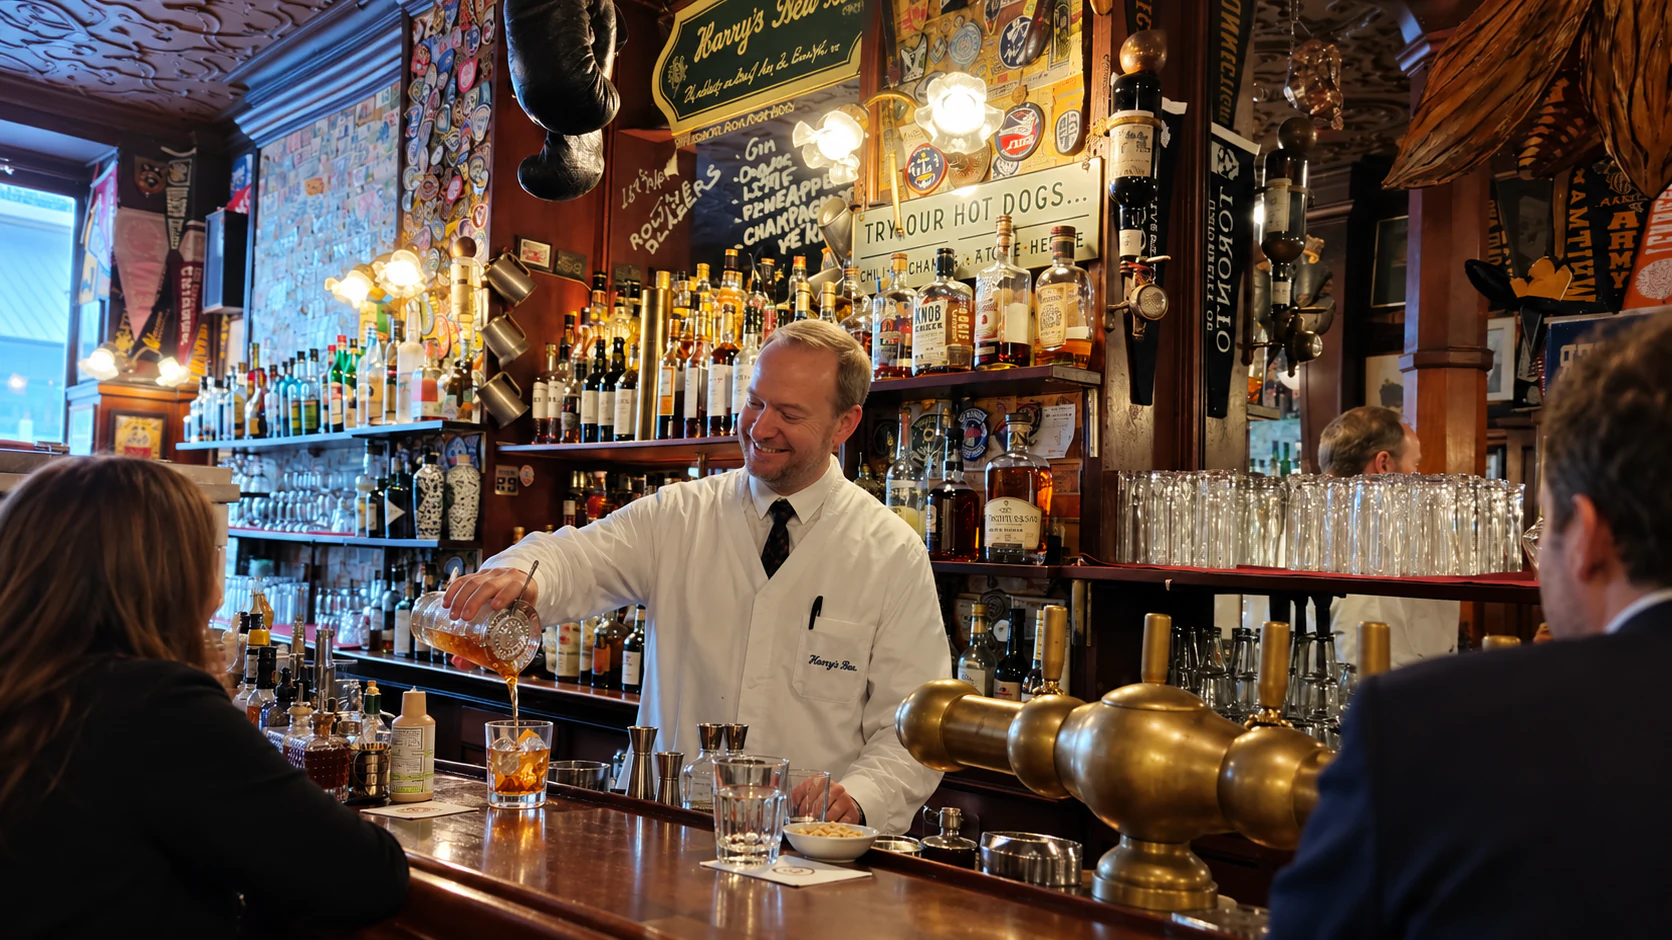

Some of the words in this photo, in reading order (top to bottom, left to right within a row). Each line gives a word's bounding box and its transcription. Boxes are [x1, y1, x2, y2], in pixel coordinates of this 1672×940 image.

[694, 8, 764, 63] Harry's
[865, 220, 897, 244] TRY
[906, 208, 945, 236] OUR
[954, 197, 992, 227] HOT
[1003, 182, 1087, 216] DOGS...
[915, 304, 941, 325] KNOB
